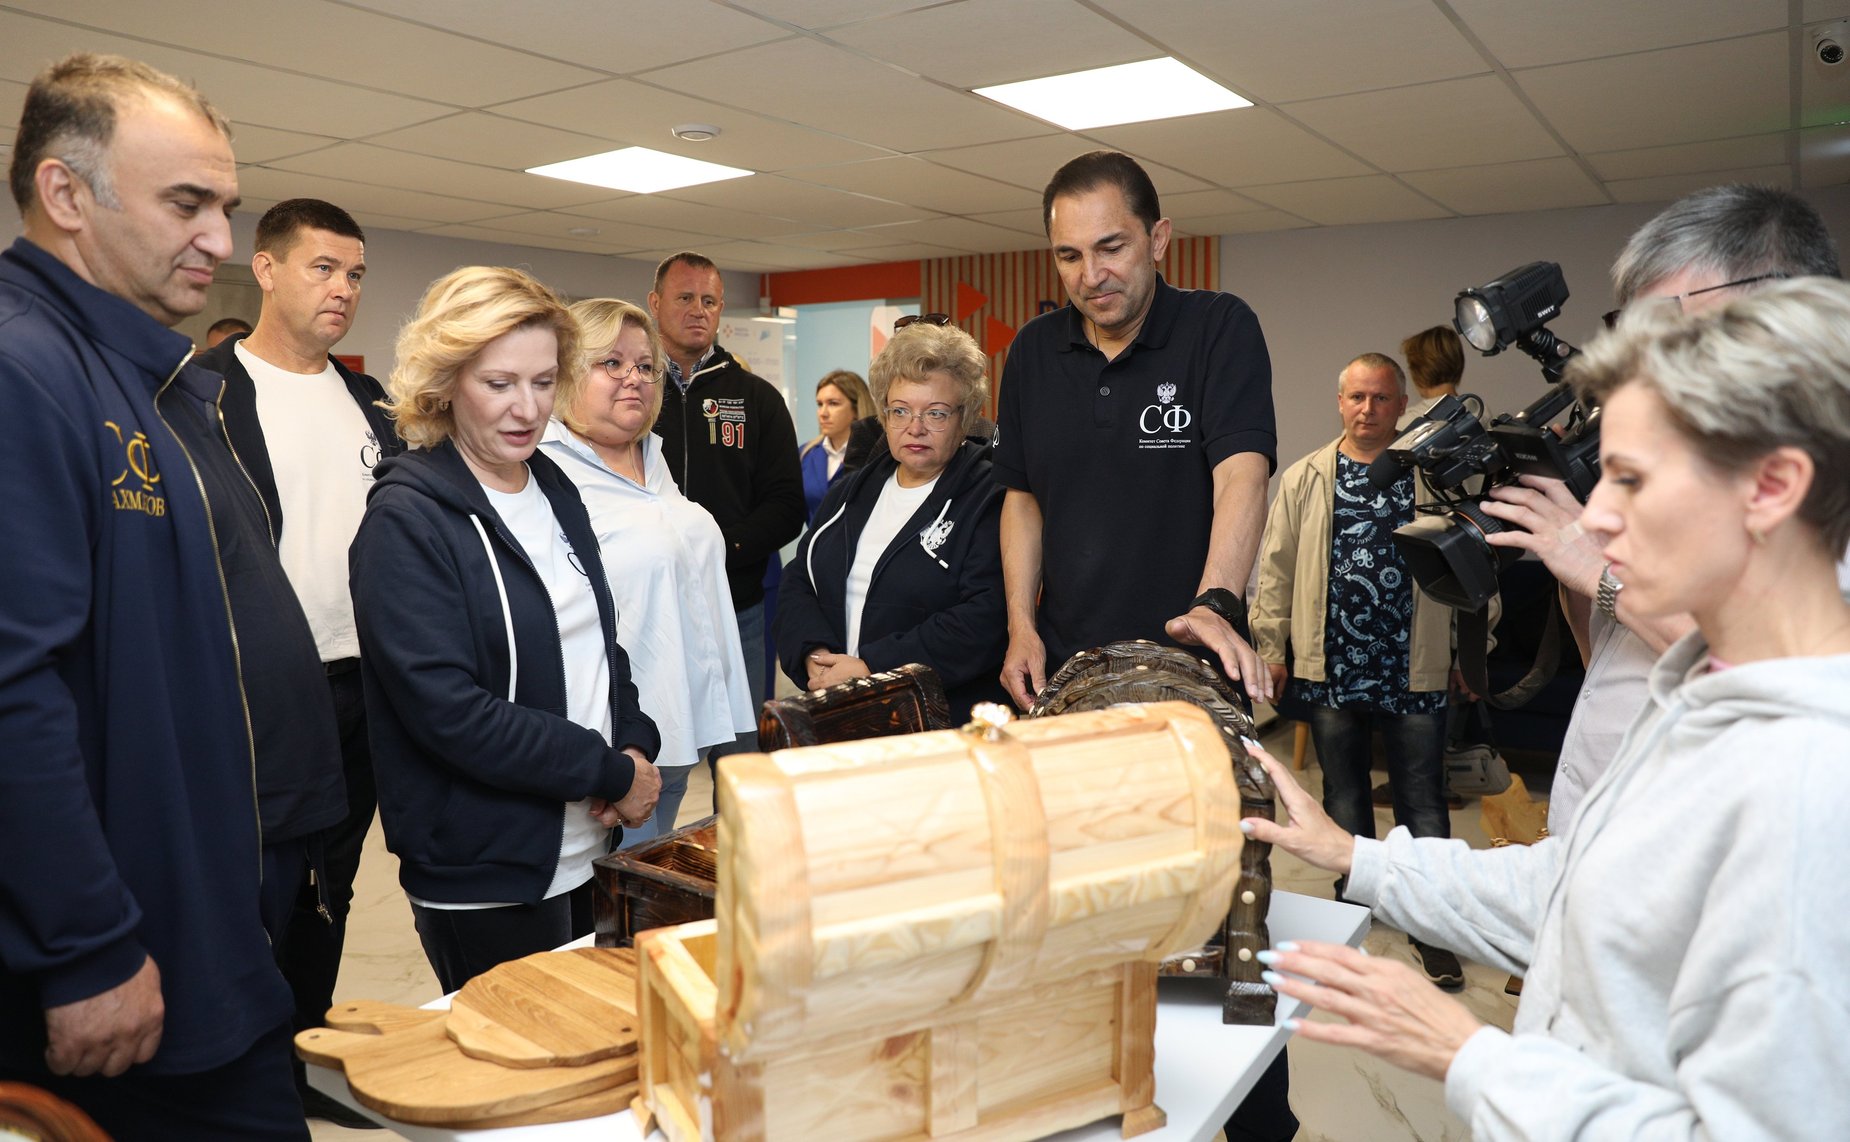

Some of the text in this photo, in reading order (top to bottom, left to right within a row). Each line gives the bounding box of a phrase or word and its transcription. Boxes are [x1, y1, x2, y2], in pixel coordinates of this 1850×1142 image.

[1537, 305, 1555, 319] SWIT
[1139, 404, 1191, 434] СФ
[721, 421, 744, 449] 91
[112, 489, 165, 516] АХМОВ
